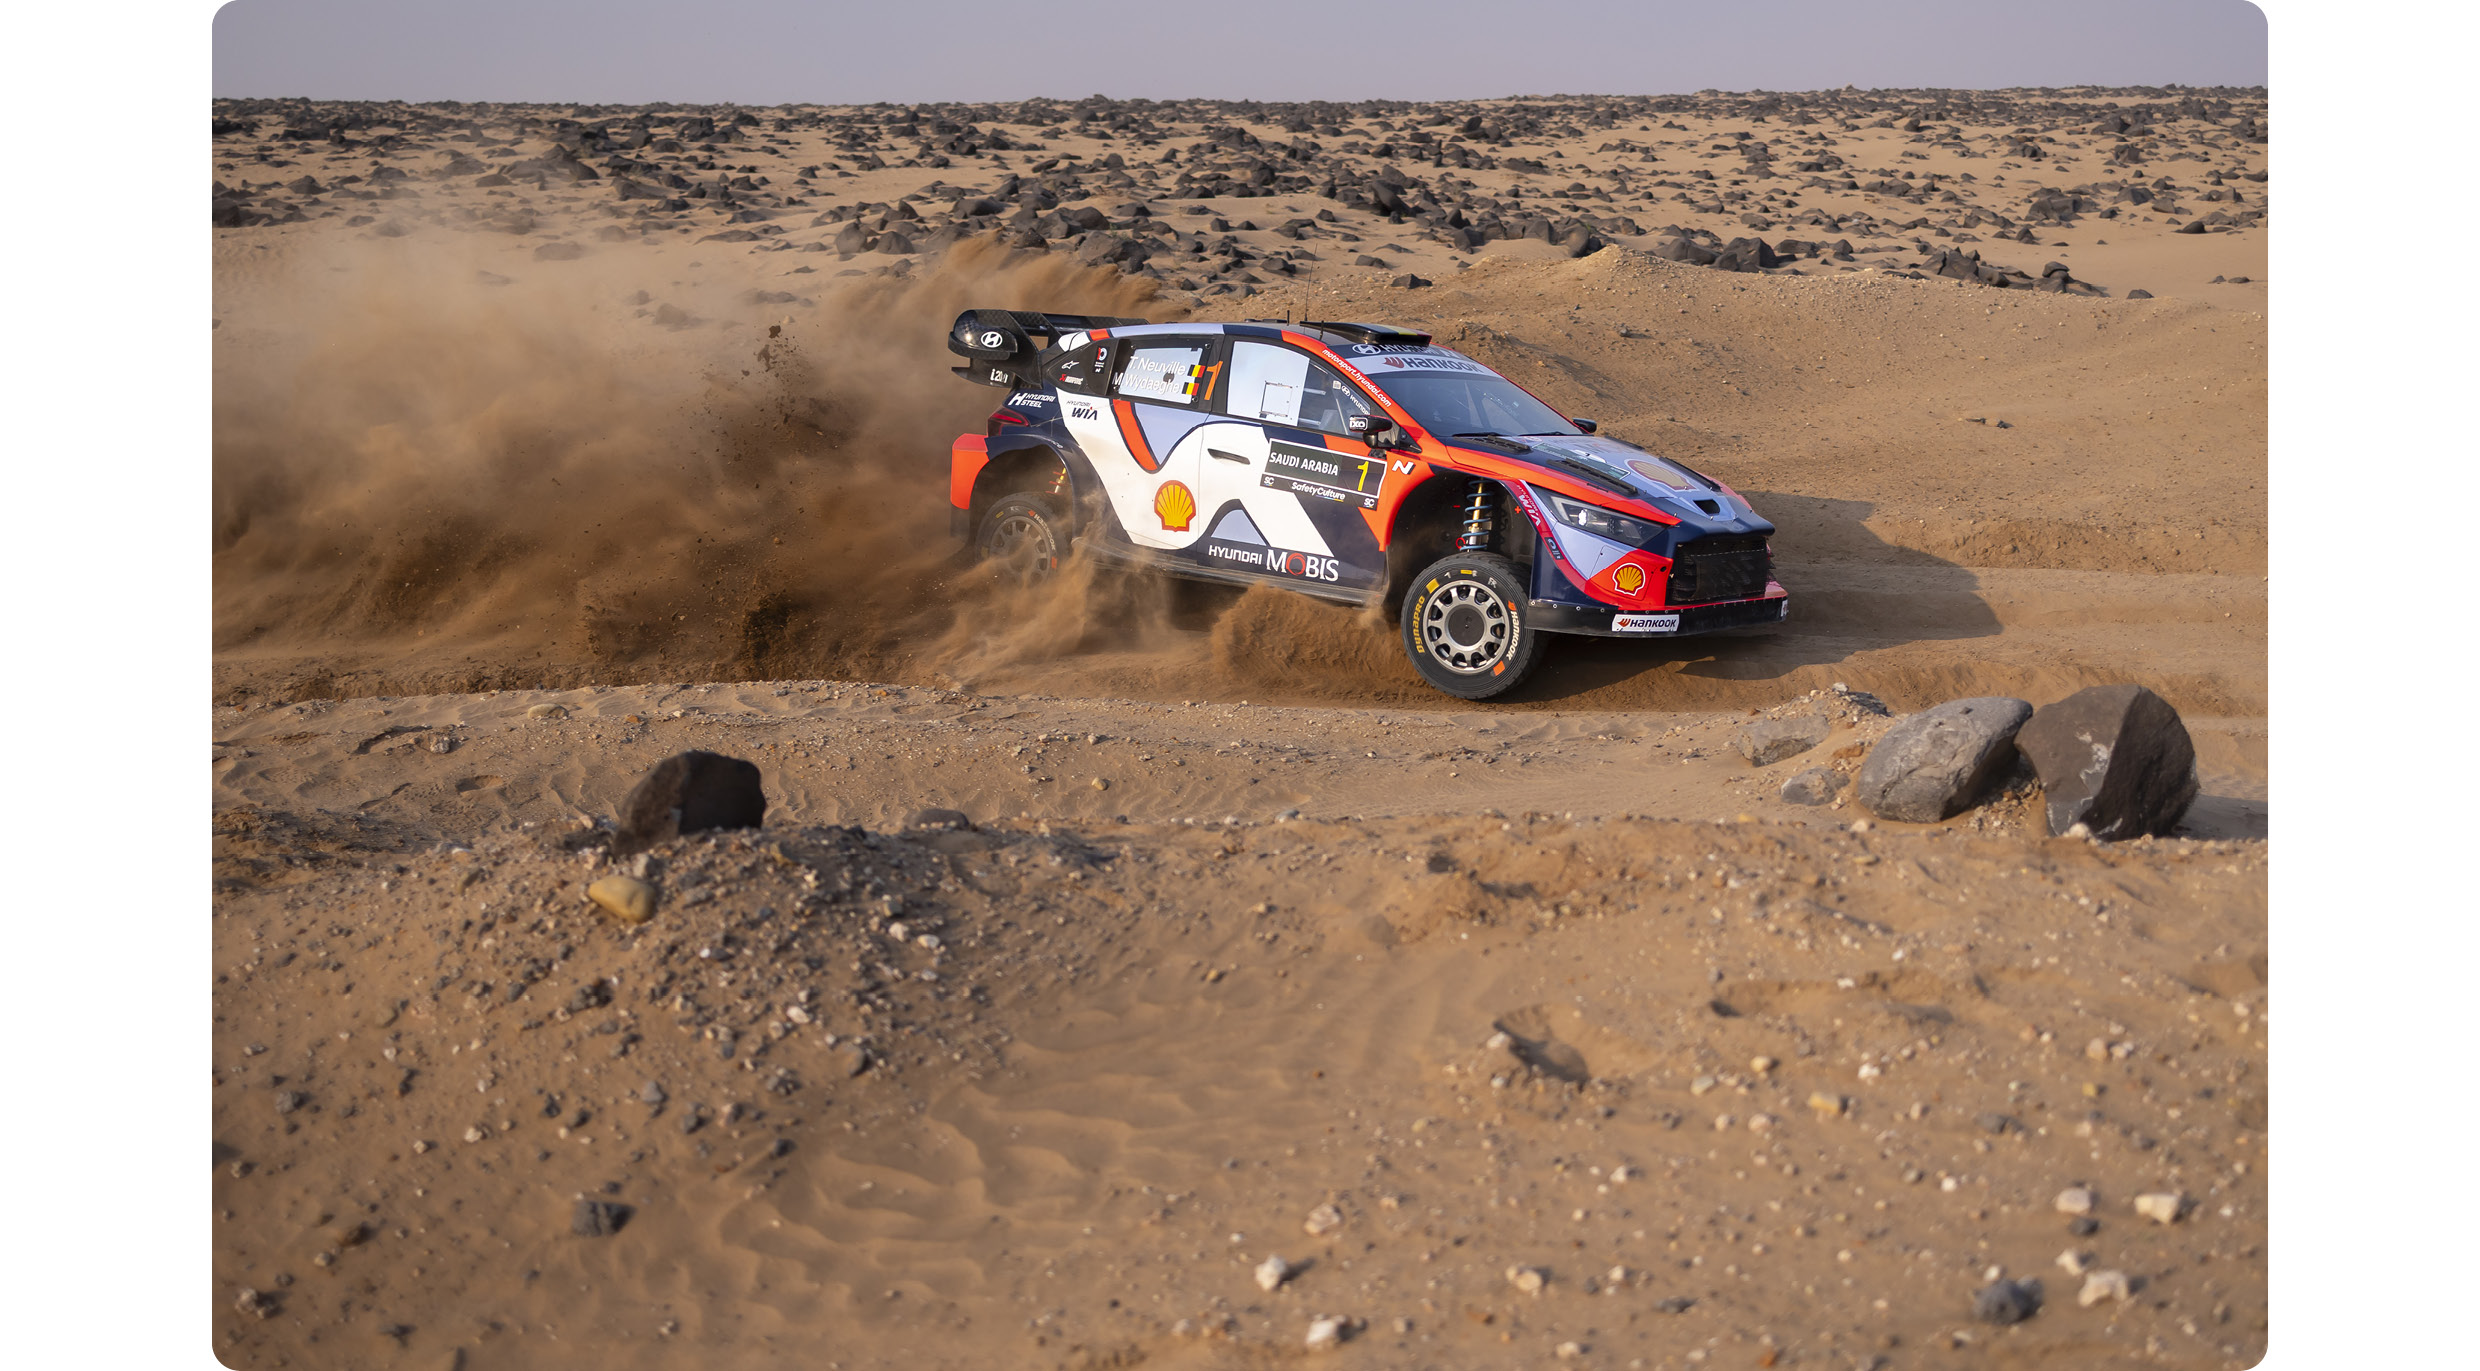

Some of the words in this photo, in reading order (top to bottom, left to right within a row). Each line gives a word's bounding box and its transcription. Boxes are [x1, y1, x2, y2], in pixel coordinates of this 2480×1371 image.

[1138, 357, 1186, 376] Neuville
[1124, 373, 1180, 395] Wydaeghe
[1203, 360, 1224, 401] 1
[1321, 348, 1392, 408] motorsport.hyundai.com
[1020, 399, 1042, 409] STEEL
[1025, 393, 1056, 403] HYUNDAI
[1071, 406, 1098, 421] WIA
[1269, 451, 1300, 468] SAUDI
[1300, 458, 1339, 476] ARABIA
[1263, 476, 1275, 486] SC
[1357, 460, 1370, 492] 1
[1291, 481, 1346, 501] SafetyCulture
[1363, 497, 1375, 508] SC
[1208, 545, 1263, 565] HYUNDAI
[1266, 549, 1339, 582] MOBIS
